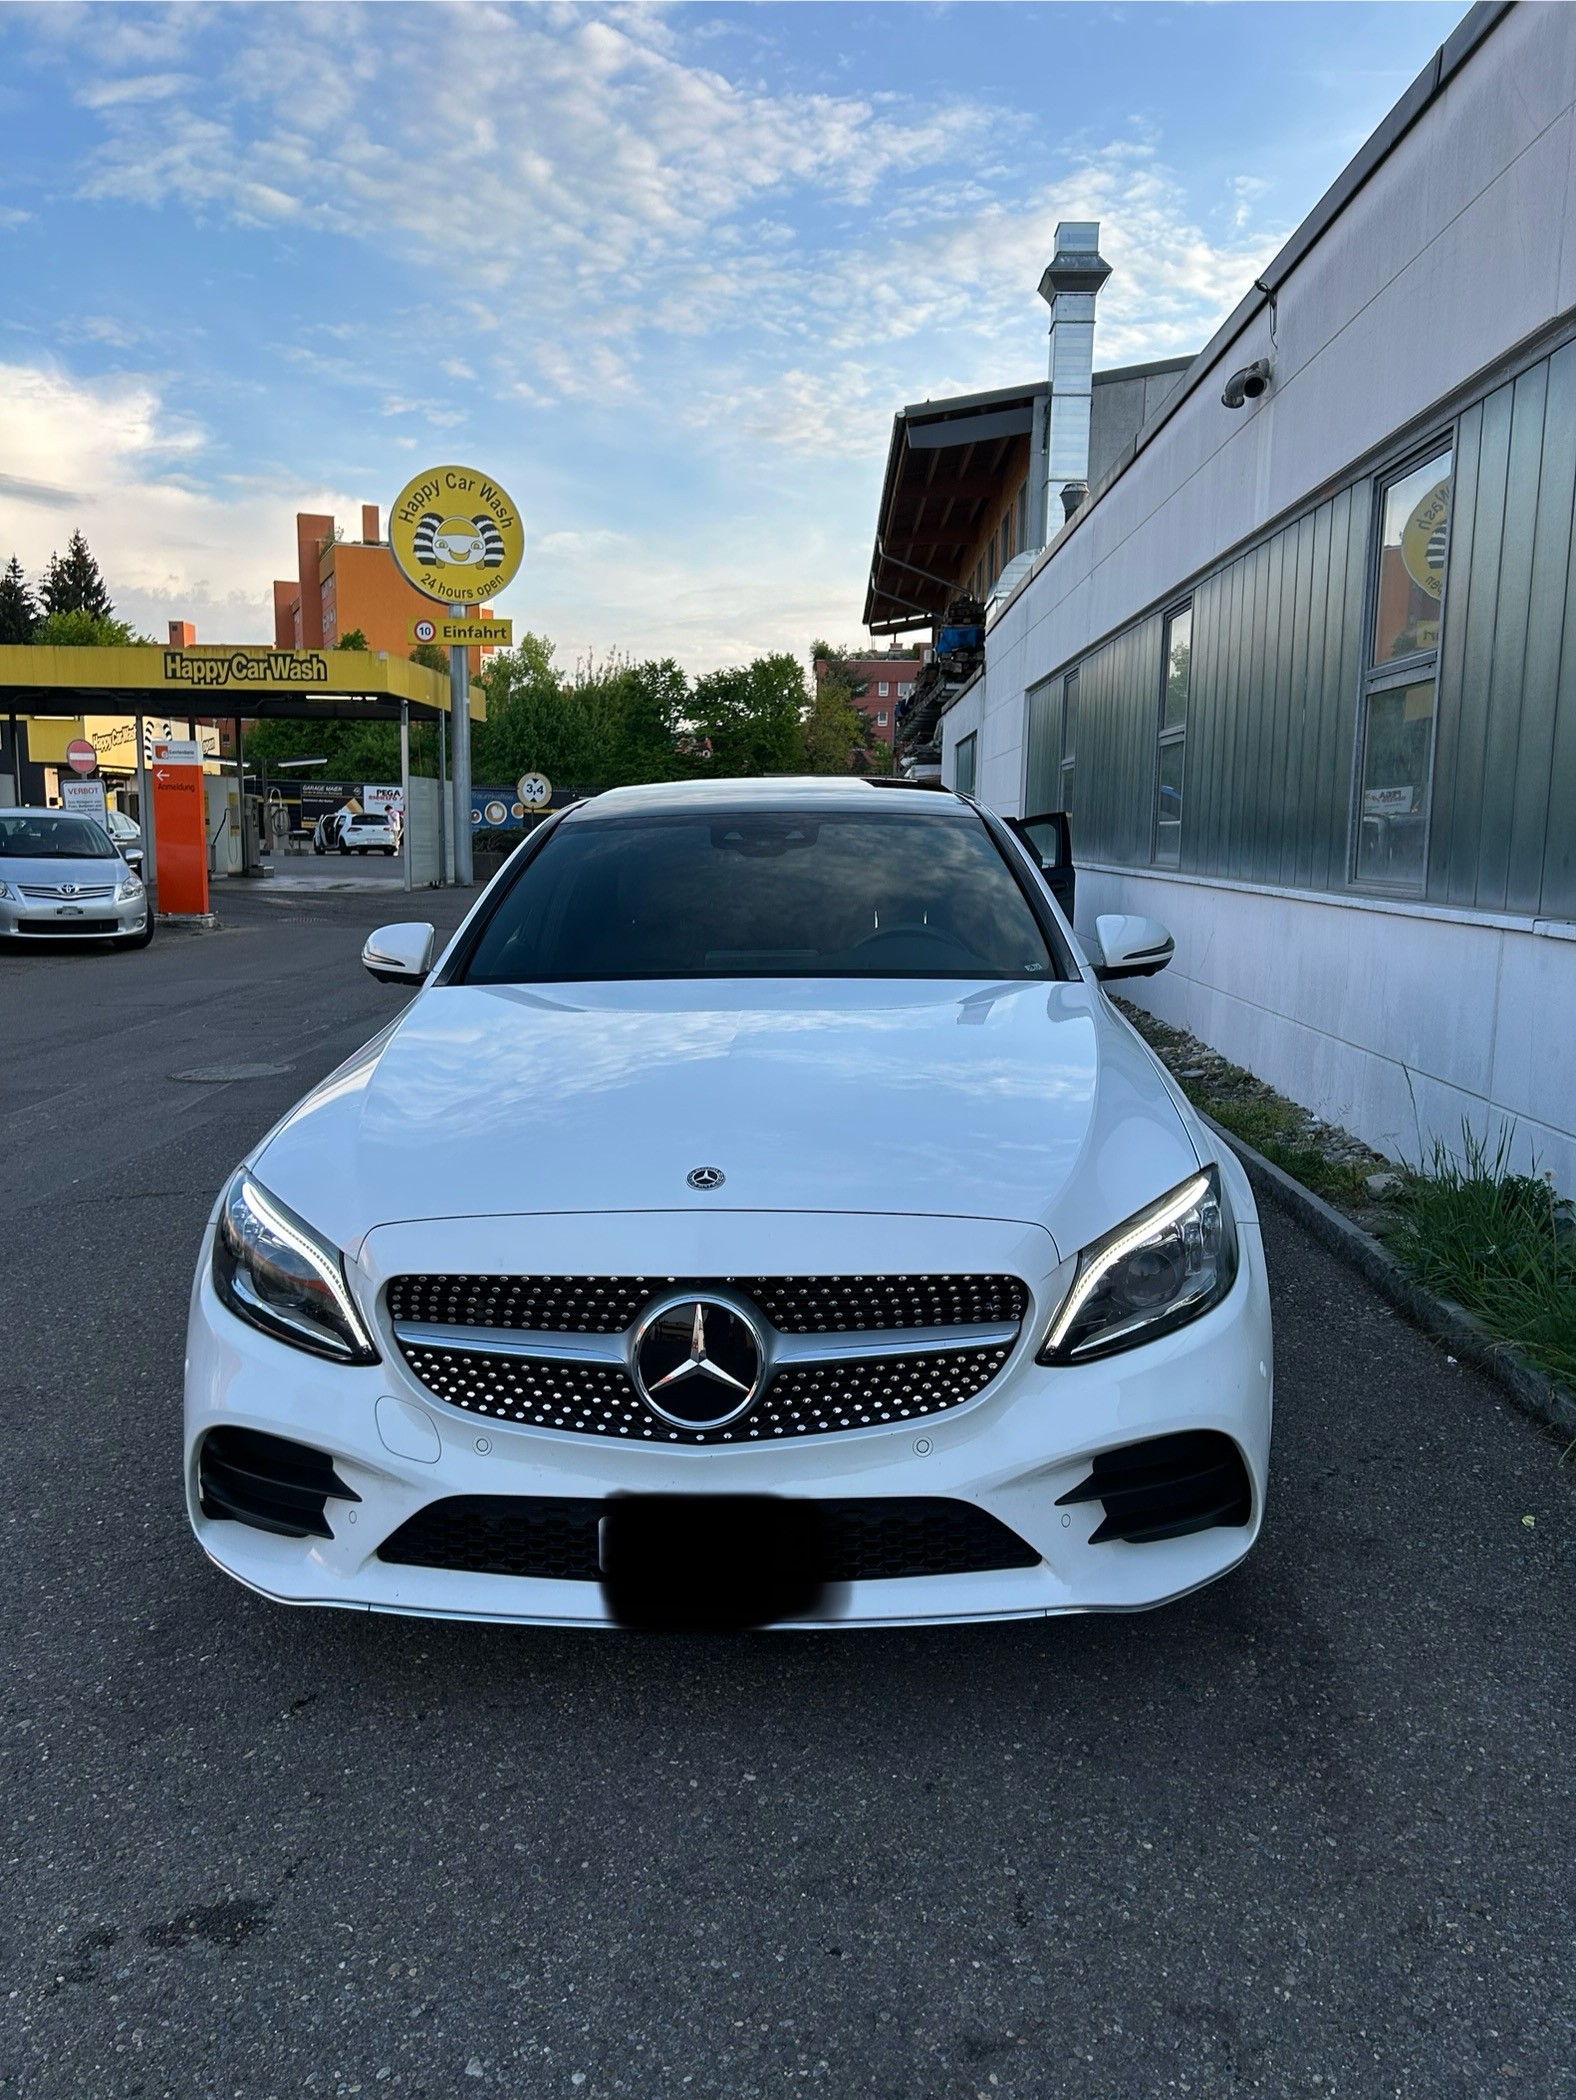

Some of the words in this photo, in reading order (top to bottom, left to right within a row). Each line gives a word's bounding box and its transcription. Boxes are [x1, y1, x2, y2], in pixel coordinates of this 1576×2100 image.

[399, 478, 440, 524] Happy
[445, 472, 475, 492] Car
[479, 482, 515, 529] Wash
[420, 573, 435, 590] 24
[437, 582, 474, 599] hours
[477, 573, 504, 597] open
[418, 626, 431, 636] 10
[443, 626, 507, 639] Einfahrt
[67, 787, 98, 795] VERBOT
[157, 783, 195, 792] Anmeldung
[526, 784, 544, 795] 3,4
